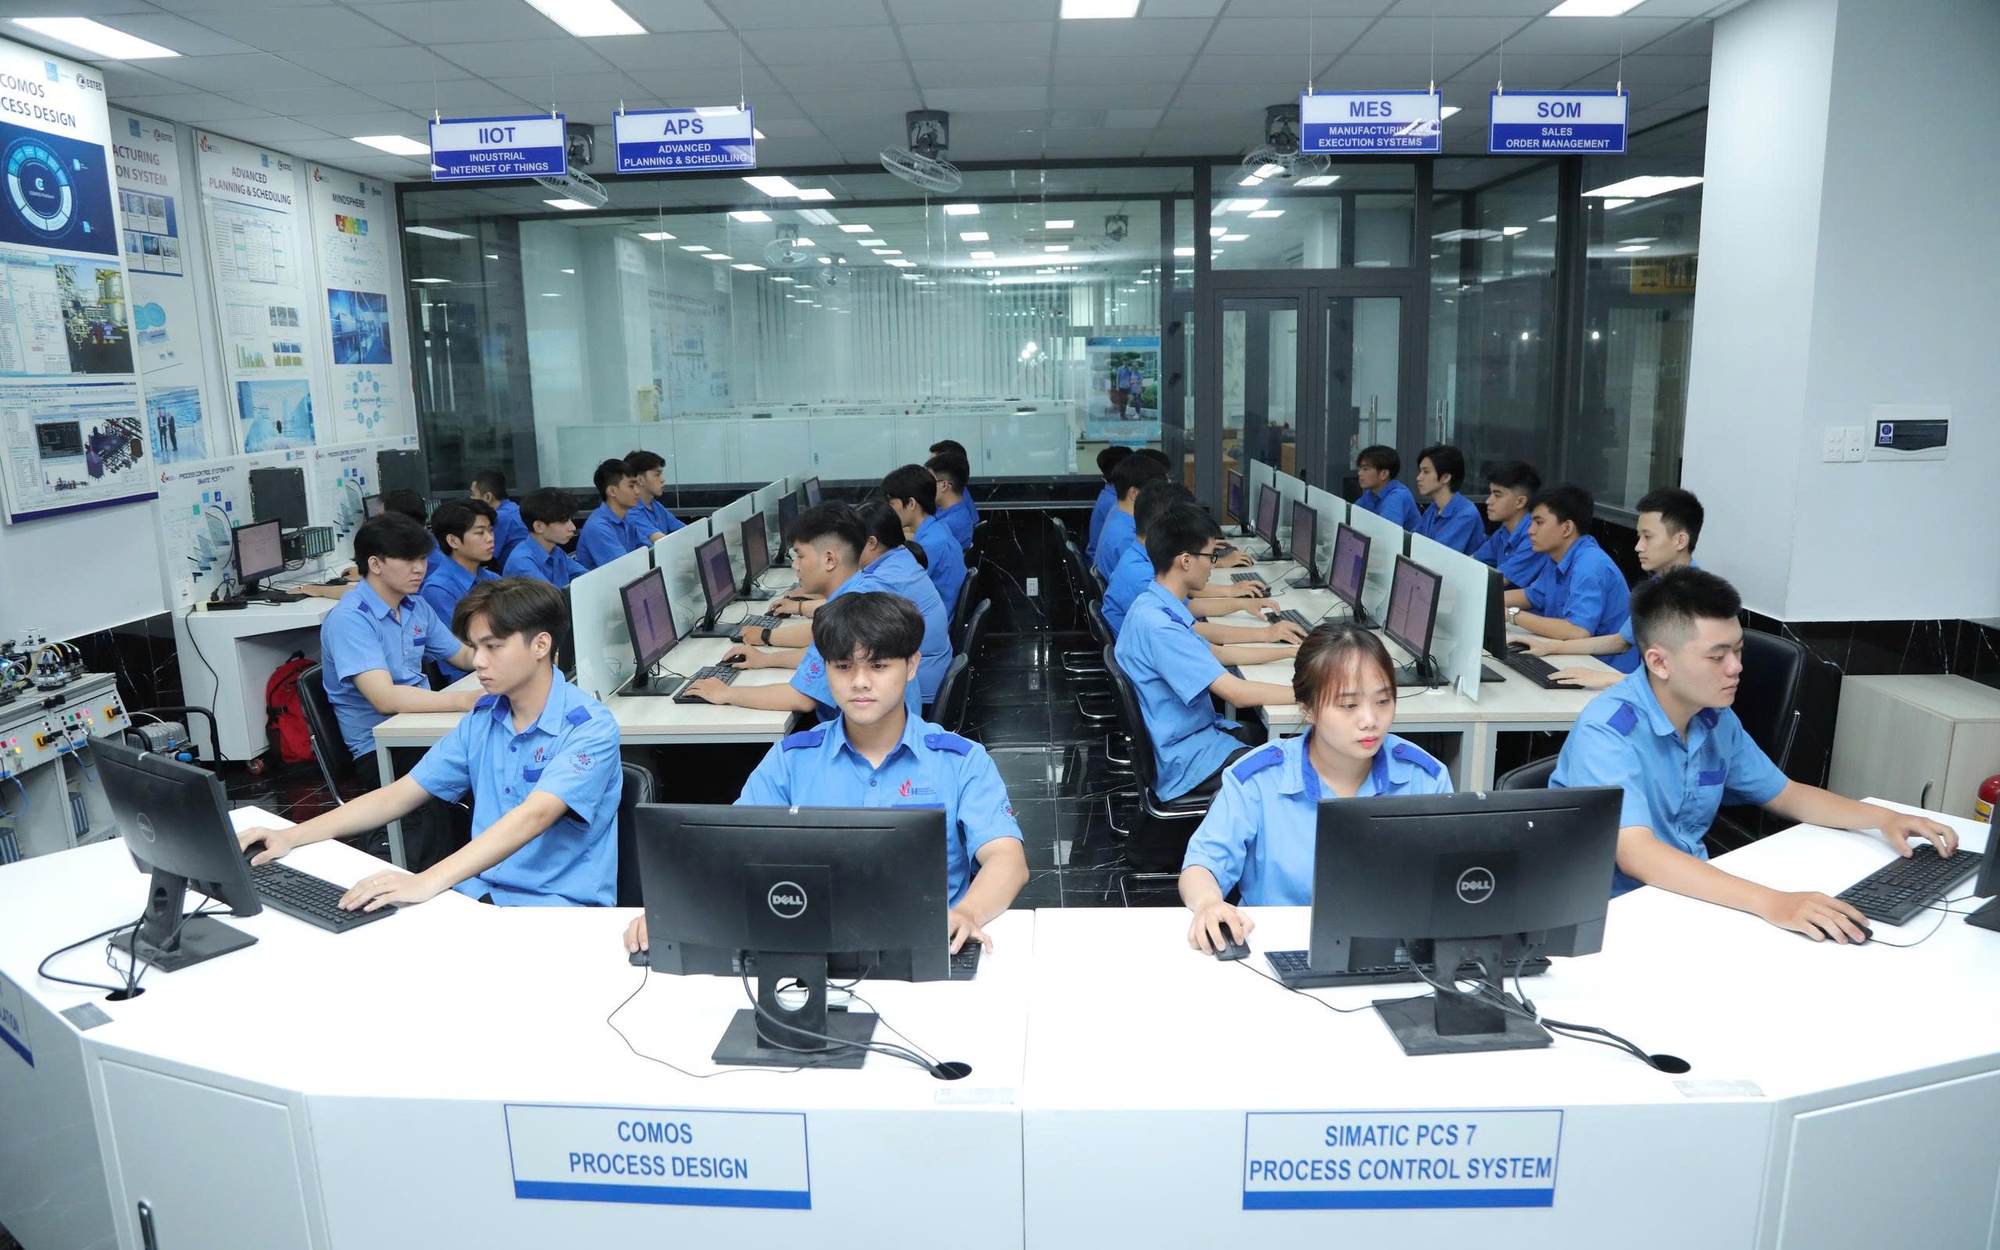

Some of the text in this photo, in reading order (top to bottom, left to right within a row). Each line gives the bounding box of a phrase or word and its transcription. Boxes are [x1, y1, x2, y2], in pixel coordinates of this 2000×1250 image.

[0, 73, 45, 98] COMOS
[33, 104, 77, 128] DESIGN
[1349, 101, 1393, 117] MES
[1537, 102, 1582, 118] SOM
[479, 126, 517, 144] IIOT
[663, 118, 704, 136] APS
[1541, 127, 1573, 136] SALES
[658, 143, 712, 154] ADVANCED
[1319, 137, 1422, 147] EXECUTION SYSTEMS
[1506, 139, 1610, 148] ORDER MANAGEMENT
[469, 152, 526, 162] INDUSTRIAL
[624, 153, 747, 167] PLANNING & SCHEDULING
[231, 166, 268, 184] ADVANCED
[450, 162, 549, 175] INTERNET OF THINGS
[132, 167, 168, 187] SYSTEM
[208, 177, 292, 205] PLANNING & SCHEDULING
[332, 193, 366, 209] MINDSPHERE
[1461, 880, 1491, 891] DELL
[772, 894, 803, 905] DELL
[617, 1121, 693, 1144] COMOS
[1324, 1124, 1478, 1147] SIMATIC PCS 7
[569, 1152, 749, 1179] PROCESS DESIGN
[1249, 1157, 1553, 1182] PROCESS CONTROL SYSTEM
